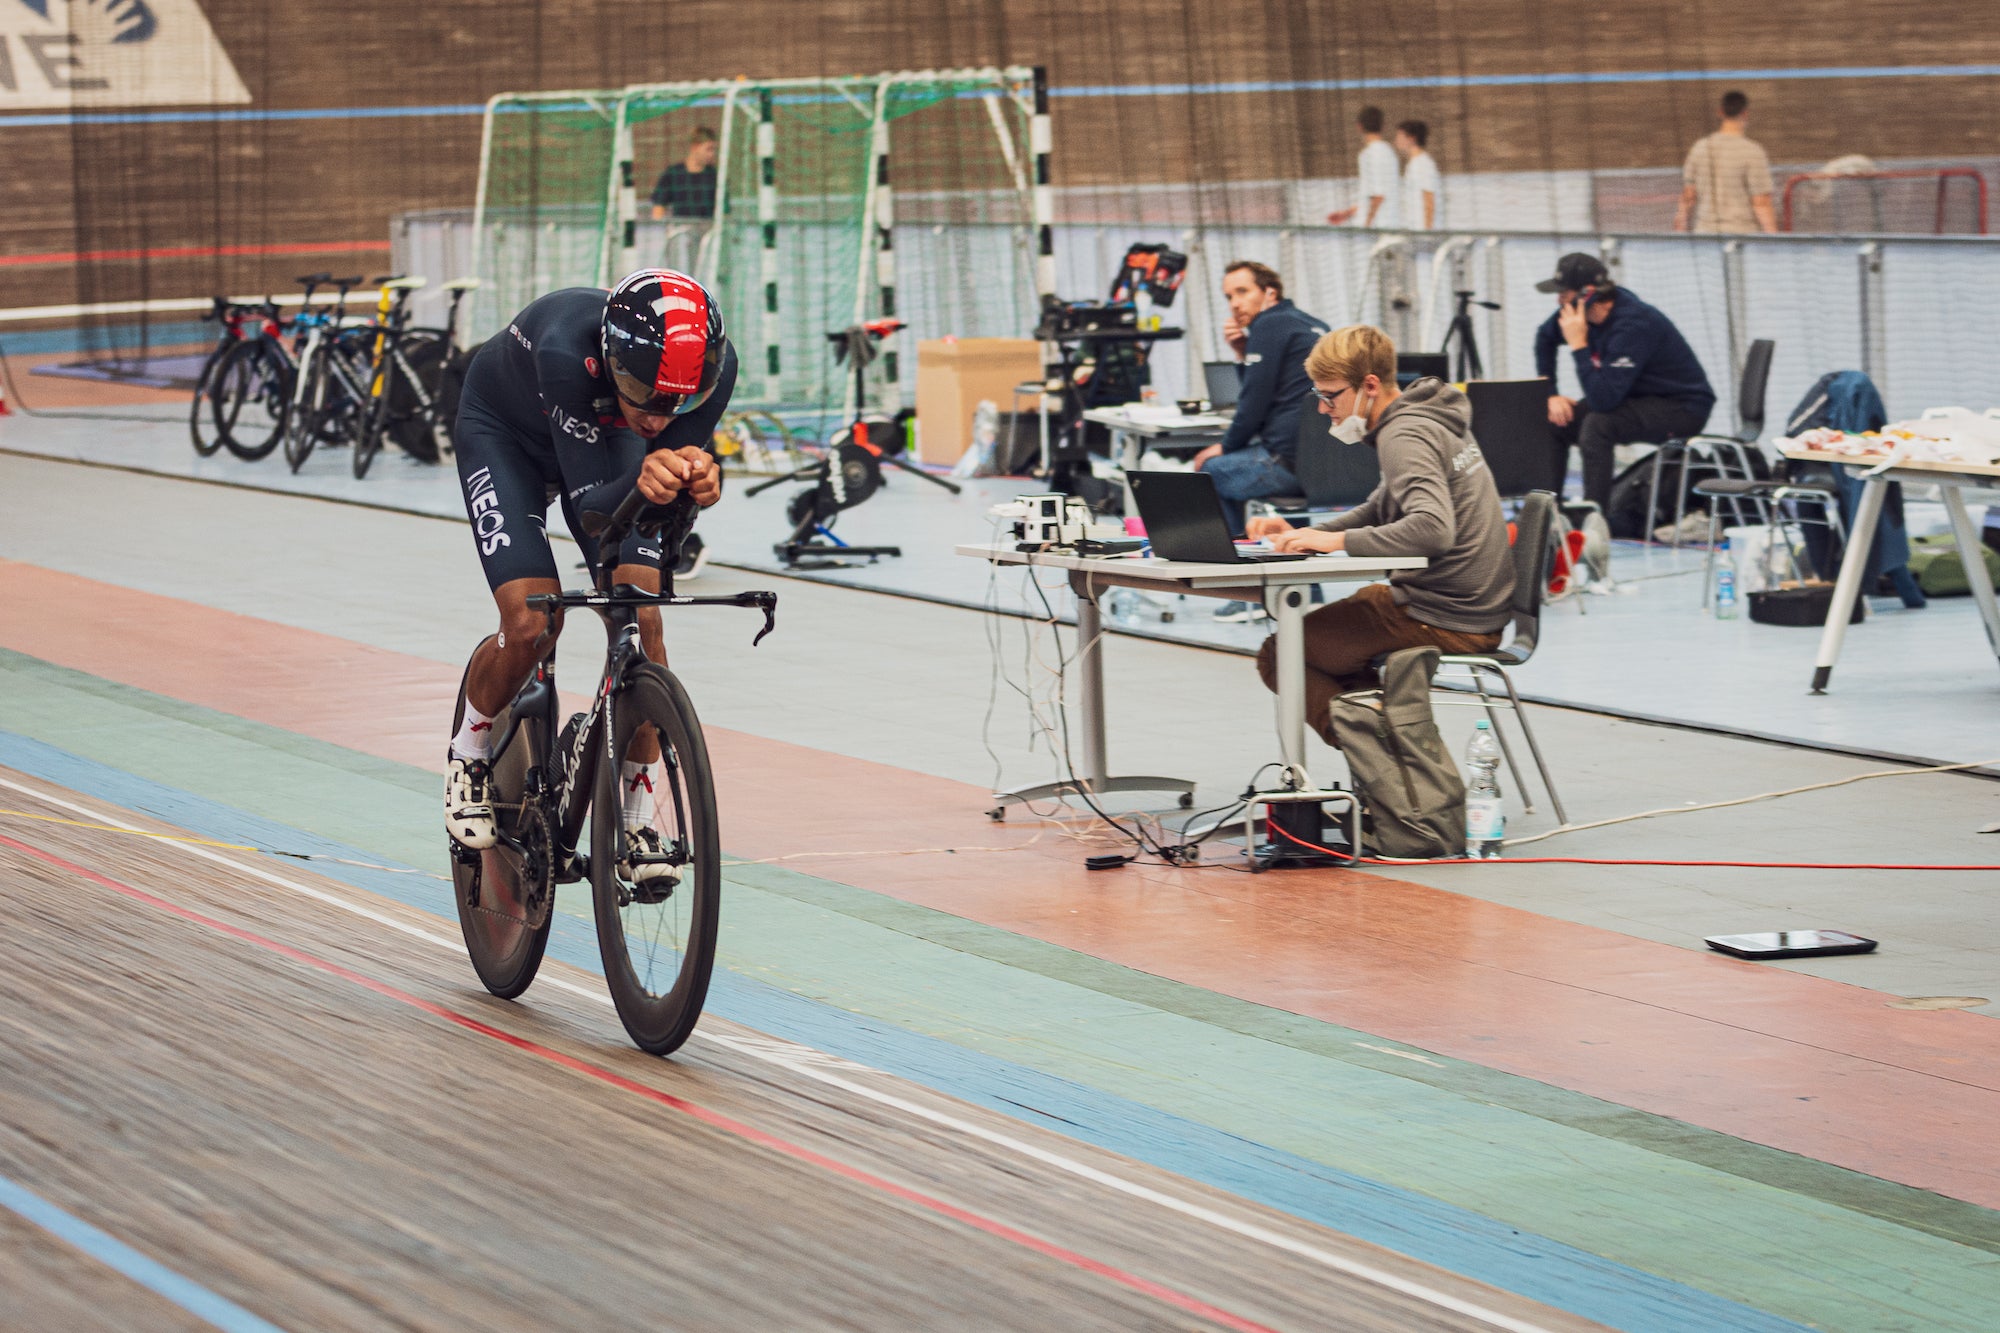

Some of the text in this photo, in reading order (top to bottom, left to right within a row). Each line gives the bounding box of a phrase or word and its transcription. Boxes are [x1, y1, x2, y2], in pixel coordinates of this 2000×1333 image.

[551, 405, 600, 443] INEOS
[466, 466, 511, 557] INEOS
[558, 677, 608, 828] PINARELLO
